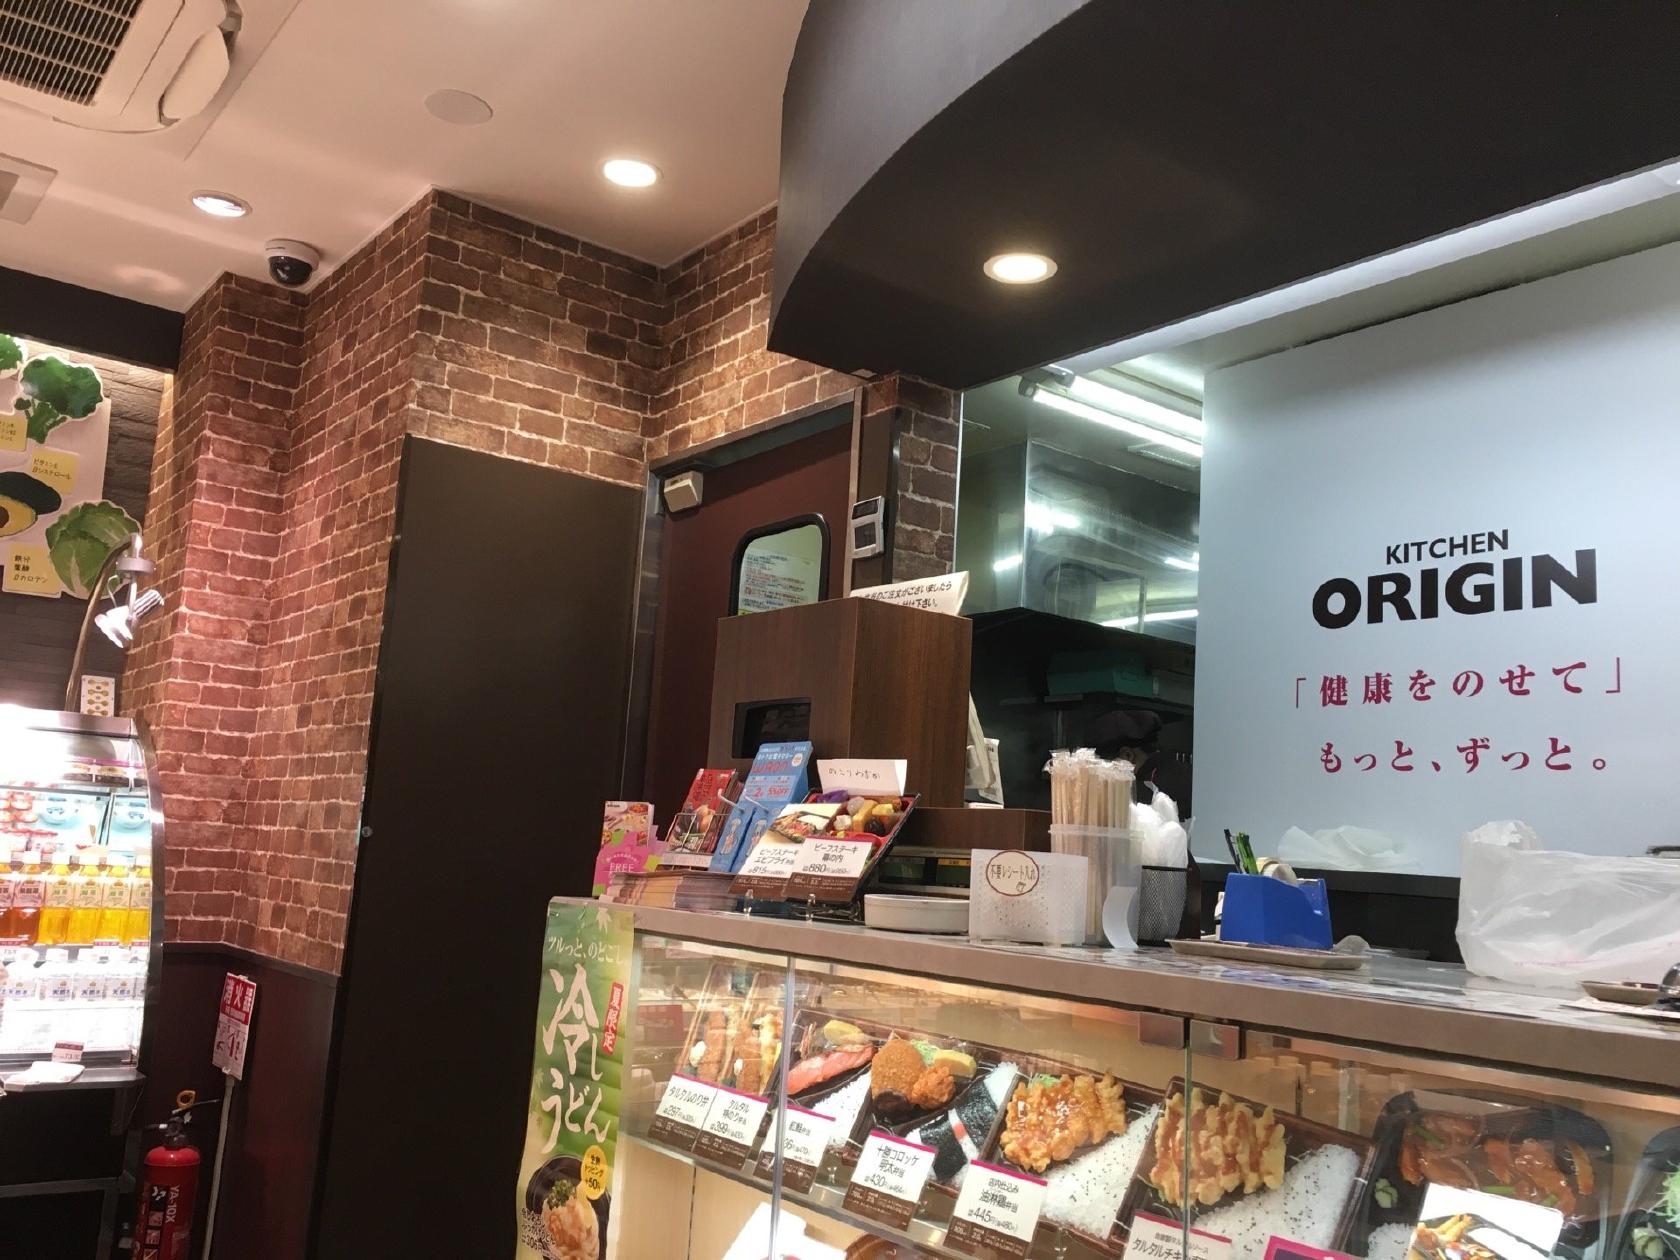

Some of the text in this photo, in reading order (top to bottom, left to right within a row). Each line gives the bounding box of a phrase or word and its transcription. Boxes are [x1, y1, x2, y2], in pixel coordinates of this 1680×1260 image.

[1386, 529, 1508, 565] KITCHEN
[1312, 548, 1597, 629] ORIGIN
[1295, 657, 1621, 709] 「健康をのせて」
[1320, 737, 1606, 774] もっと、ずっと。
[759, 848, 799, 856] ビーフステーキ
[815, 843, 859, 855] ビーフステーキ
[821, 853, 844, 864] 幕の内
[610, 862, 635, 873] FREE
[223, 979, 255, 1013] 消火器
[165, 1185, 180, 1223] YA-10X
